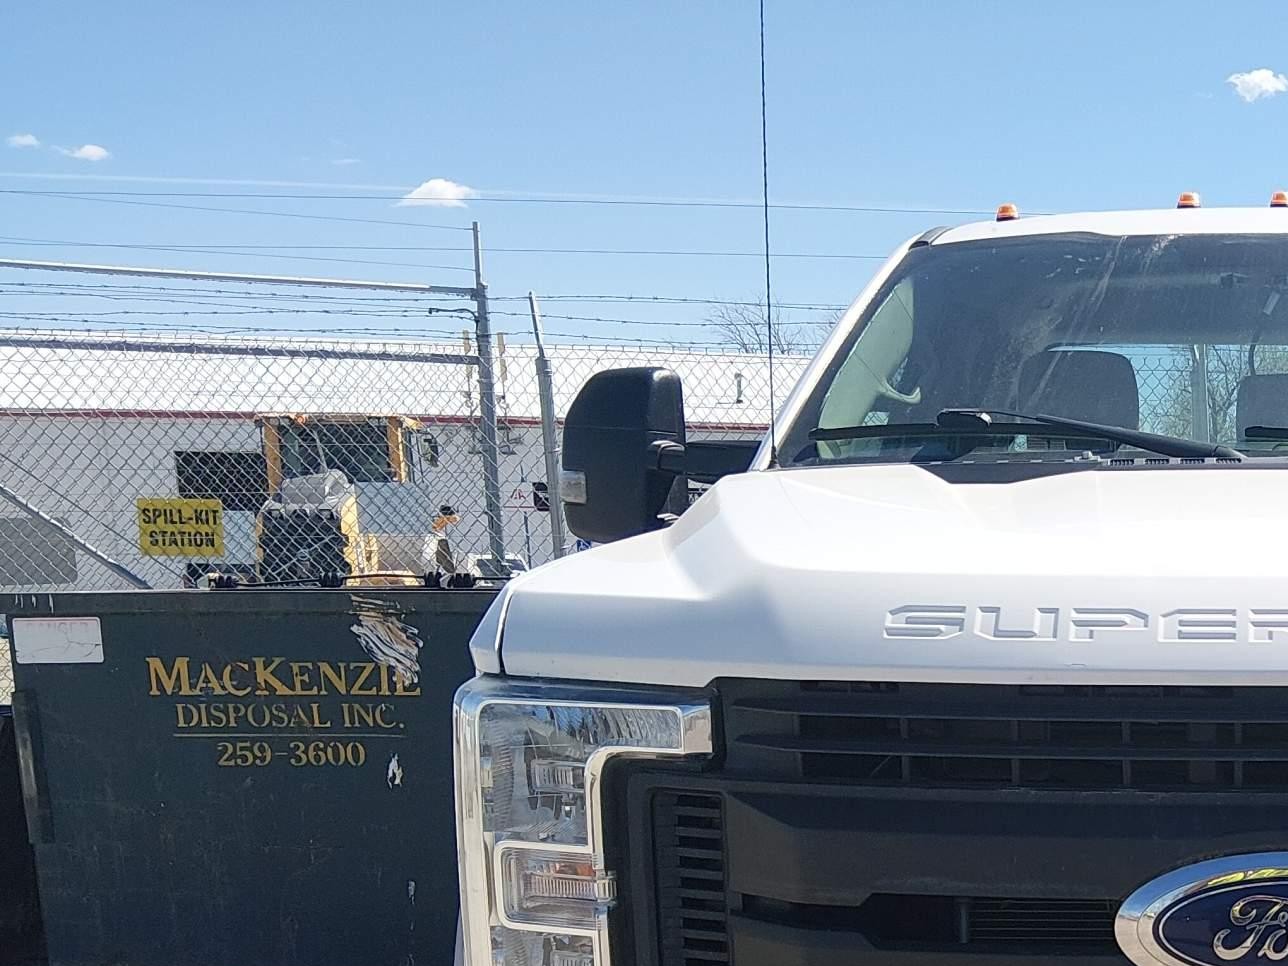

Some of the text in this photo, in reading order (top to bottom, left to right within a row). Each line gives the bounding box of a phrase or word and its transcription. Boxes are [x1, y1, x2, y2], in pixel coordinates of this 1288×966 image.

[142, 508, 219, 525] SPILL-KIT
[149, 531, 215, 547] STATION
[175, 703, 405, 728] DISPOSAL INC.
[216, 742, 366, 766] 259-3600
